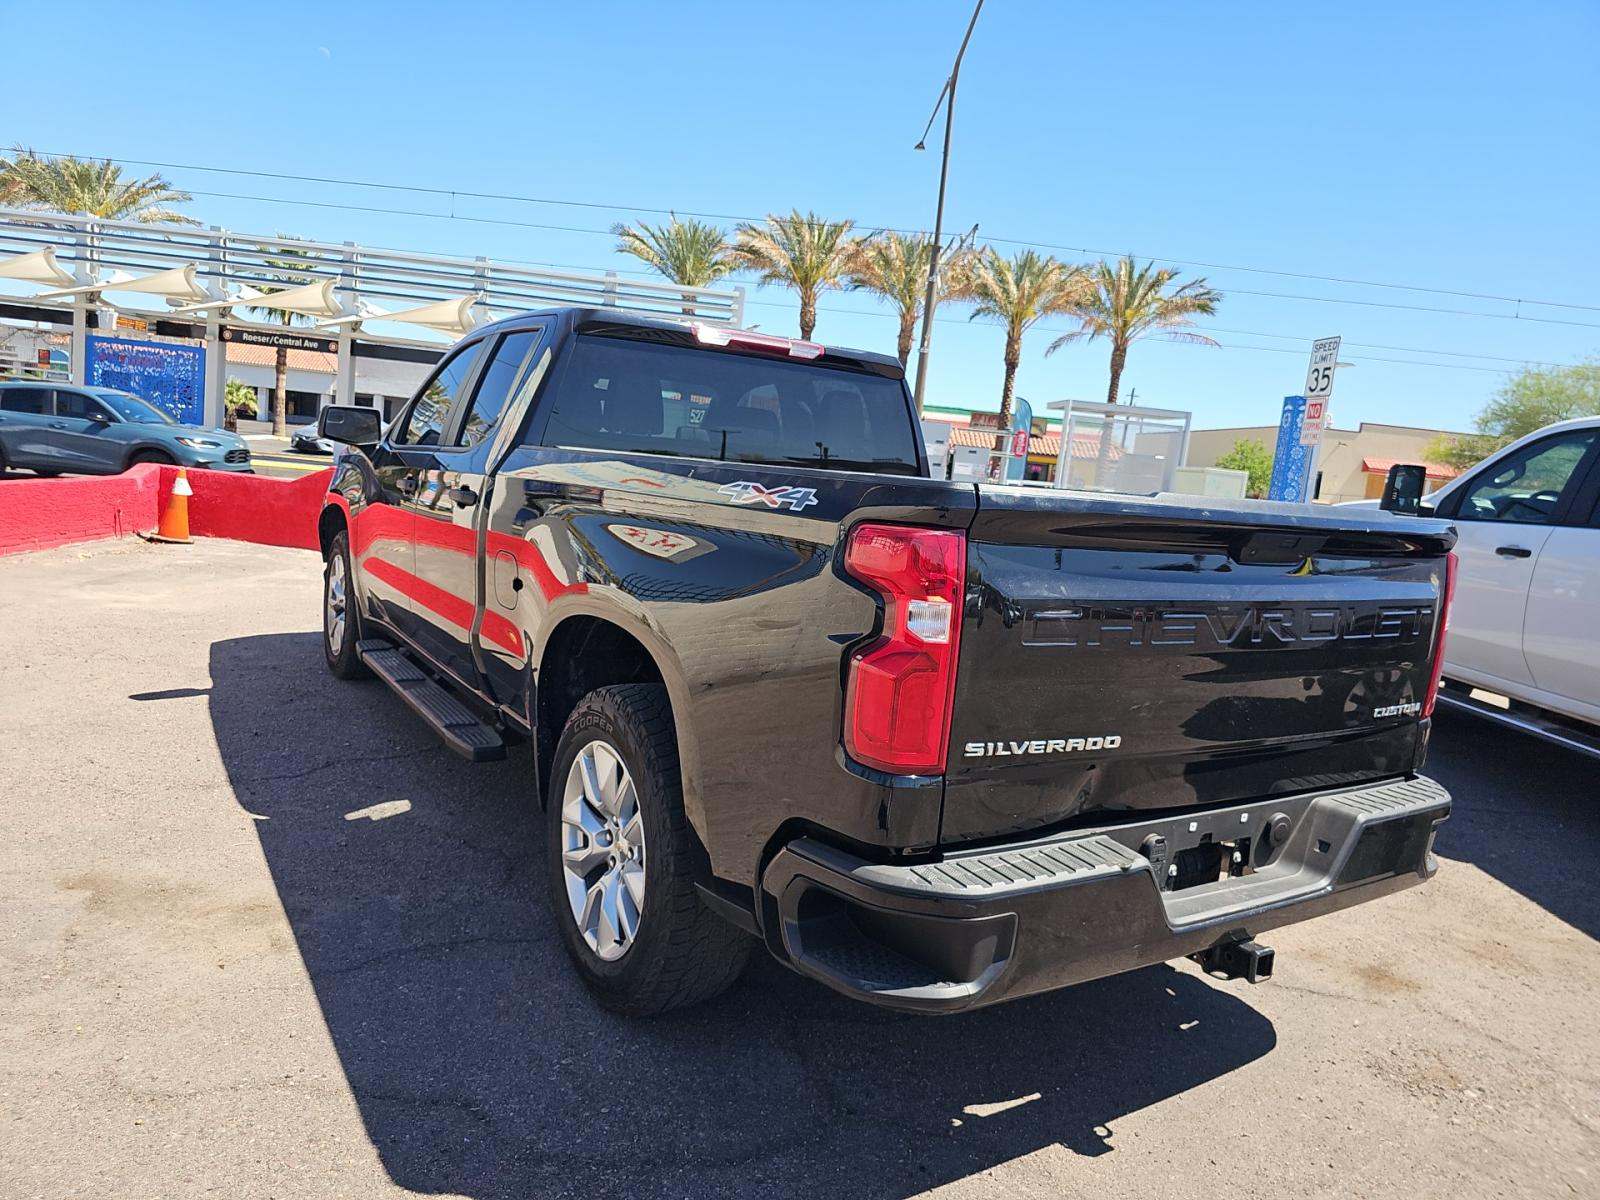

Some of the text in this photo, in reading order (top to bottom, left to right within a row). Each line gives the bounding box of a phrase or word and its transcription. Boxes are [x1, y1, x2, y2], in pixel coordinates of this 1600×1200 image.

[242, 333, 303, 347] Roeser/Central
[303, 340, 319, 349] Ave
[1314, 341, 1337, 353] SPEED
[1314, 353, 1332, 364] LIMIT
[1308, 367, 1331, 392] 35
[1308, 404, 1321, 418] NO
[1021, 606, 1433, 647] CHEVROLET
[1373, 702, 1421, 718] CUSTOM
[573, 715, 614, 735] COOPER
[963, 735, 1122, 757] SILVERADO
